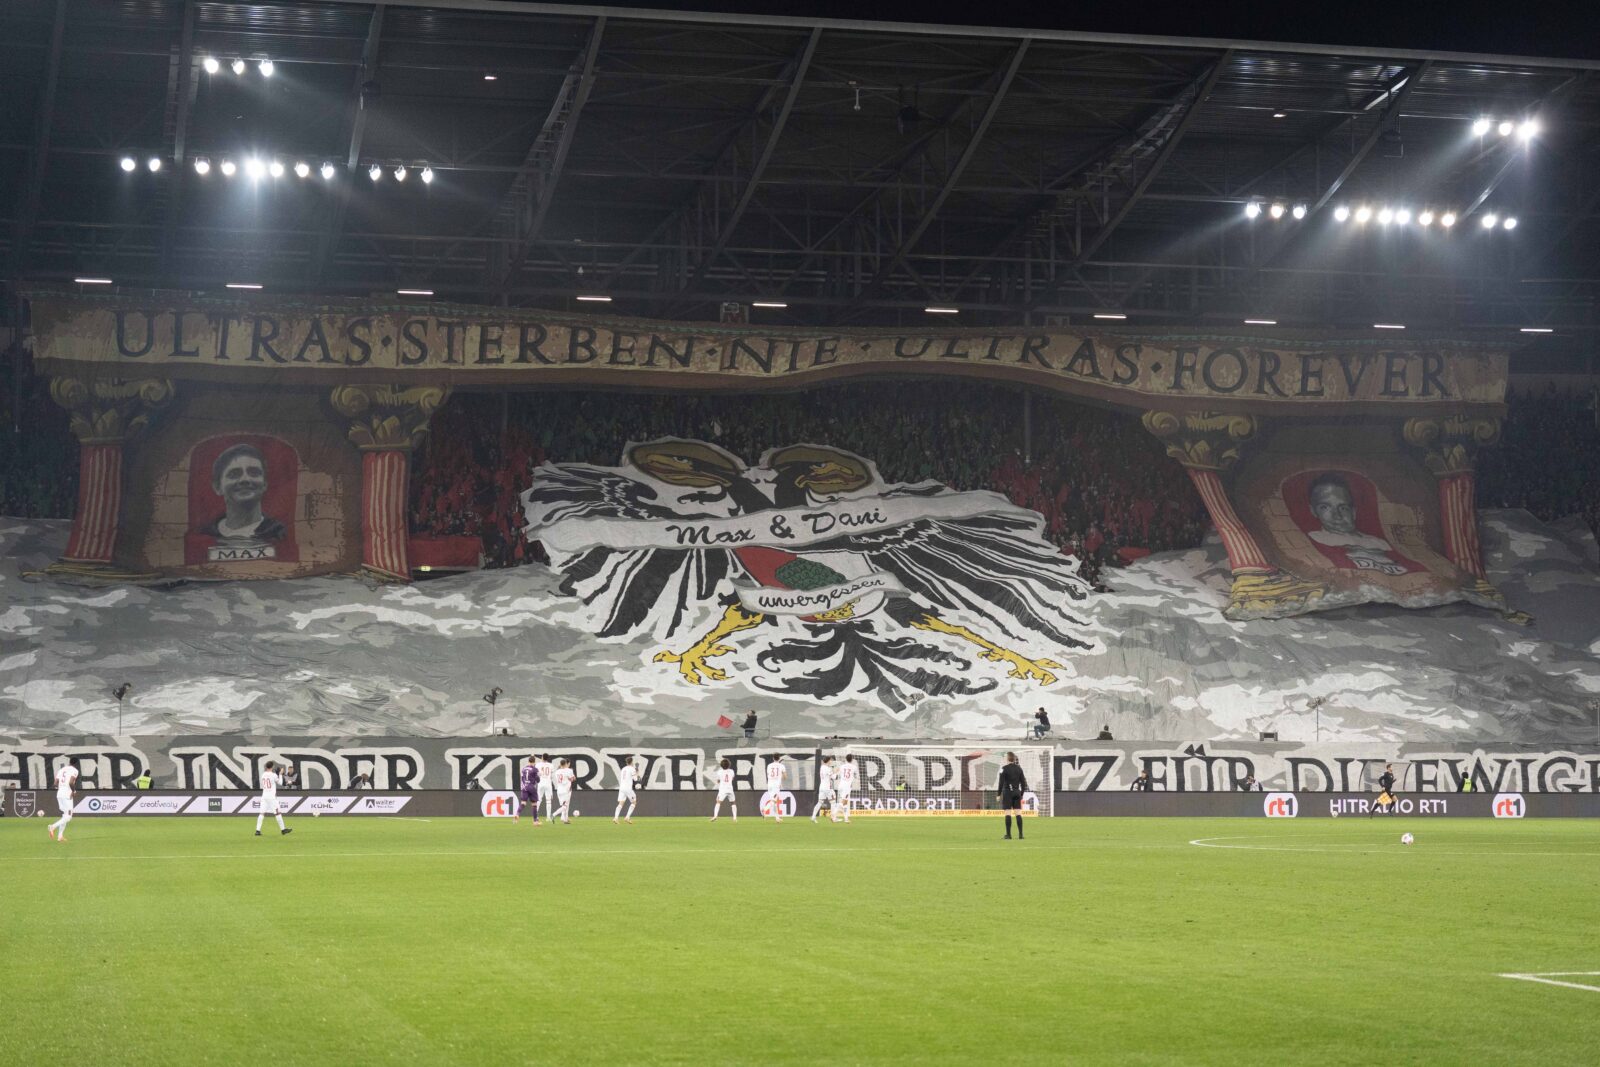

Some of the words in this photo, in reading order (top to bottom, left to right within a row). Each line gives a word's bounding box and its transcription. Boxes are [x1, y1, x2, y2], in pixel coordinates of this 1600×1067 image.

[113, 309, 372, 366] ULTRAS
[402, 318, 696, 367] STERBEN
[723, 337, 840, 373] NIE
[894, 335, 1143, 385] ULTRAS
[1168, 348, 1453, 398] FOREVER
[664, 525, 755, 545] Max
[769, 514, 795, 539] &
[802, 508, 887, 534] Dani
[217, 549, 267, 560] MAX
[758, 578, 885, 610] unvergessen
[770, 767, 779, 777] 31
[843, 768, 851, 778] 13
[1409, 756, 1600, 792] EWIG
[486, 796, 514, 815] rt1
[849, 797, 919, 810] TRADIO
[927, 798, 956, 810] RT1
[1268, 798, 1294, 815] rt1
[1419, 799, 1448, 814] RT1
[1496, 798, 1521, 815] rt1
